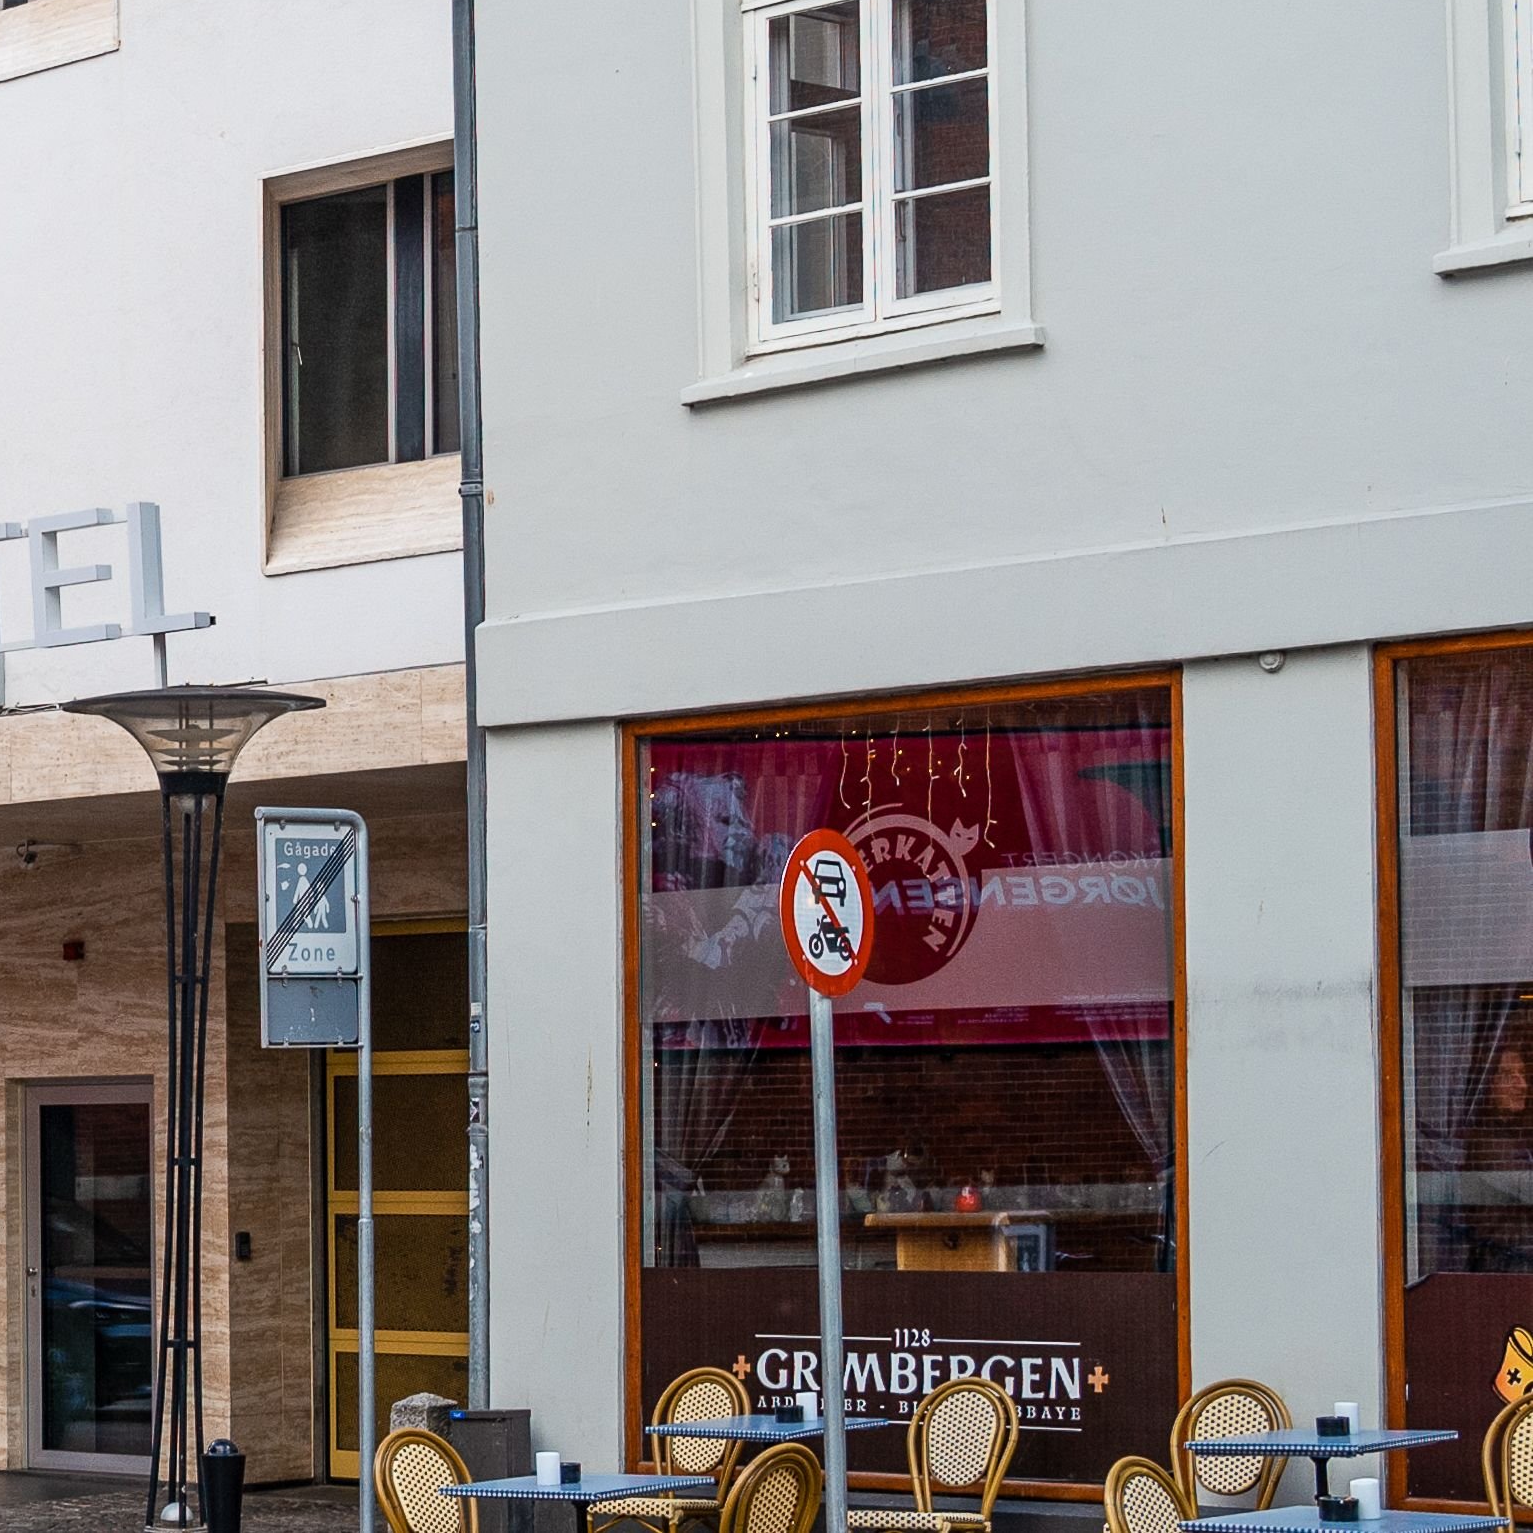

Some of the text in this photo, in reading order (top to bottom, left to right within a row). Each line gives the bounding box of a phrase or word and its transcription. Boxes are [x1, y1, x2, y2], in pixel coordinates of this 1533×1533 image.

[288, 942, 336, 962] Zone
[894, 1328, 931, 1348] 1128
[756, 1348, 1082, 1400] GRMBERGEN
